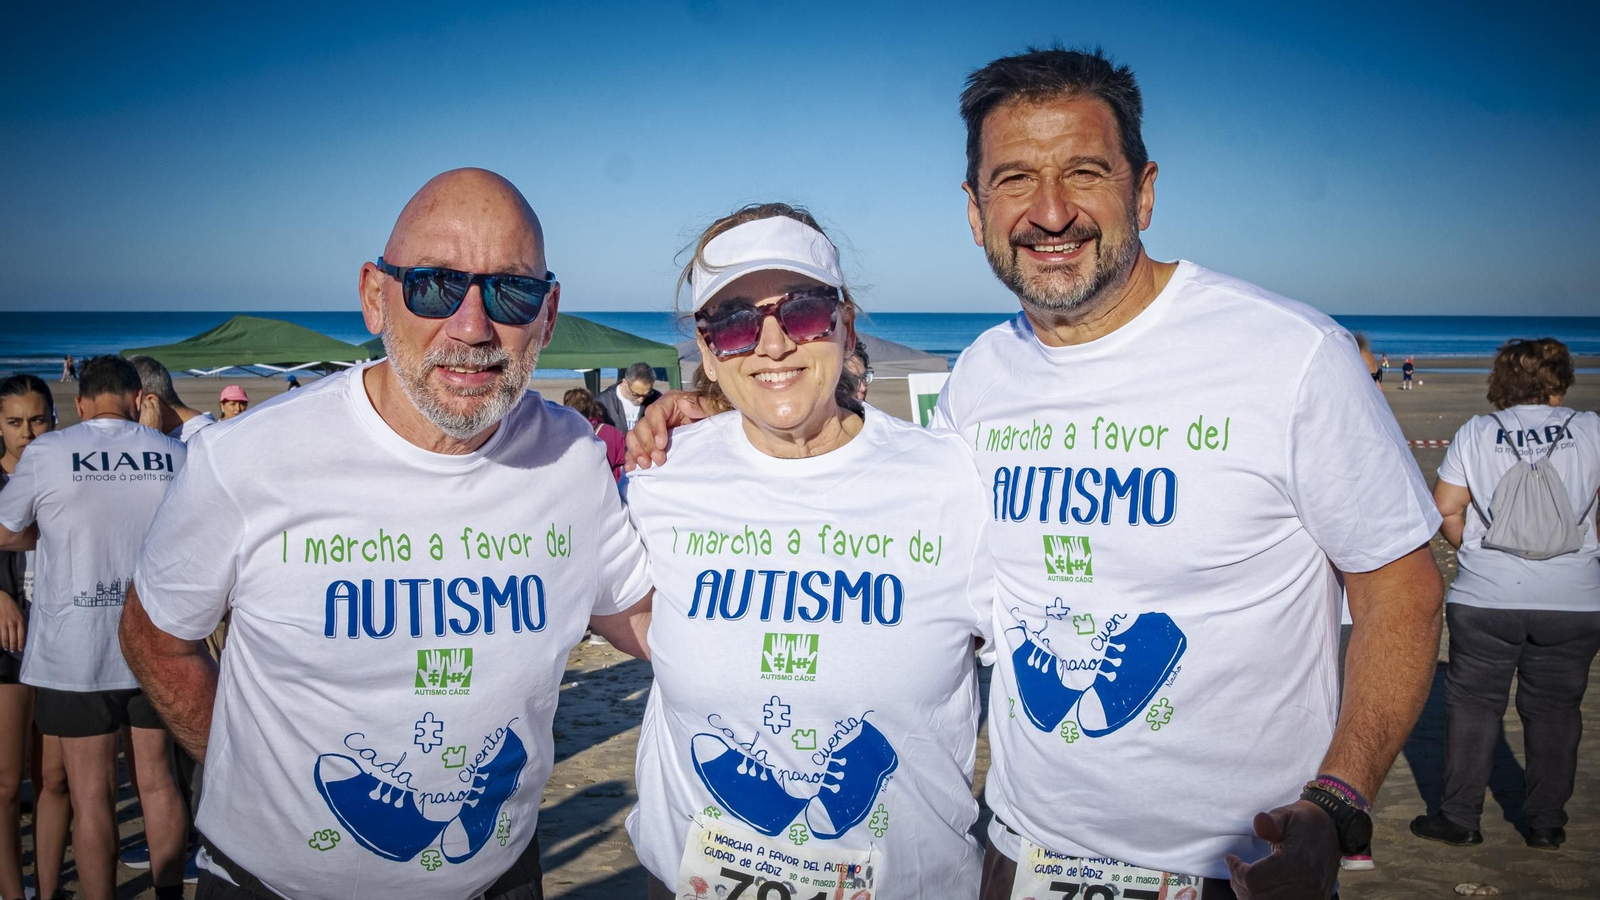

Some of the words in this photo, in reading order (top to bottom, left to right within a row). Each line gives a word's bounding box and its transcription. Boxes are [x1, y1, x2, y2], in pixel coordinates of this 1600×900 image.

[986, 419, 1053, 453] marcha
[1064, 422, 1078, 450] a
[1091, 415, 1170, 453] favor
[1187, 414, 1231, 452] del
[1496, 425, 1573, 447] KIABI
[72, 451, 174, 472] KIABI
[1495, 446, 1503, 454] la
[1505, 447, 1530, 456] mde
[72, 474, 82, 482] la
[86, 473, 116, 482] mode
[119, 473, 127, 481] à
[130, 473, 157, 482] petits
[993, 465, 1178, 527] AUTISMO
[304, 527, 412, 565] marcha
[429, 532, 444, 561] a
[460, 526, 533, 562] favor
[546, 522, 572, 559] del
[686, 524, 773, 557] marcha
[788, 527, 802, 555] a
[818, 524, 895, 559] favor
[908, 529, 943, 566] del
[1047, 575, 1074, 583] AUTISMO
[323, 574, 549, 640] AUTISMO
[687, 568, 905, 627] AUTISMO
[1091, 613, 1128, 651] cuen
[760, 673, 793, 681] AUTISMO
[794, 674, 816, 682] CÁDIZ
[414, 688, 447, 696] AUTISMO
[448, 688, 470, 696] CÁDIZ
[778, 769, 824, 791] paso
[812, 710, 875, 766] cuenta
[343, 732, 419, 792] Cada
[419, 790, 470, 817] paso
[458, 716, 519, 783] cuenta
[714, 833, 753, 853] MARCHA
[756, 846, 765, 856] A
[769, 850, 799, 867] FAVOR
[803, 860, 820, 872] DEL
[740, 858, 752, 868] de
[789, 873, 798, 881] 30
[800, 876, 809, 884] de
[1067, 867, 1078, 877] de
[1111, 874, 1120, 882] 30
[1123, 875, 1133, 883] de
